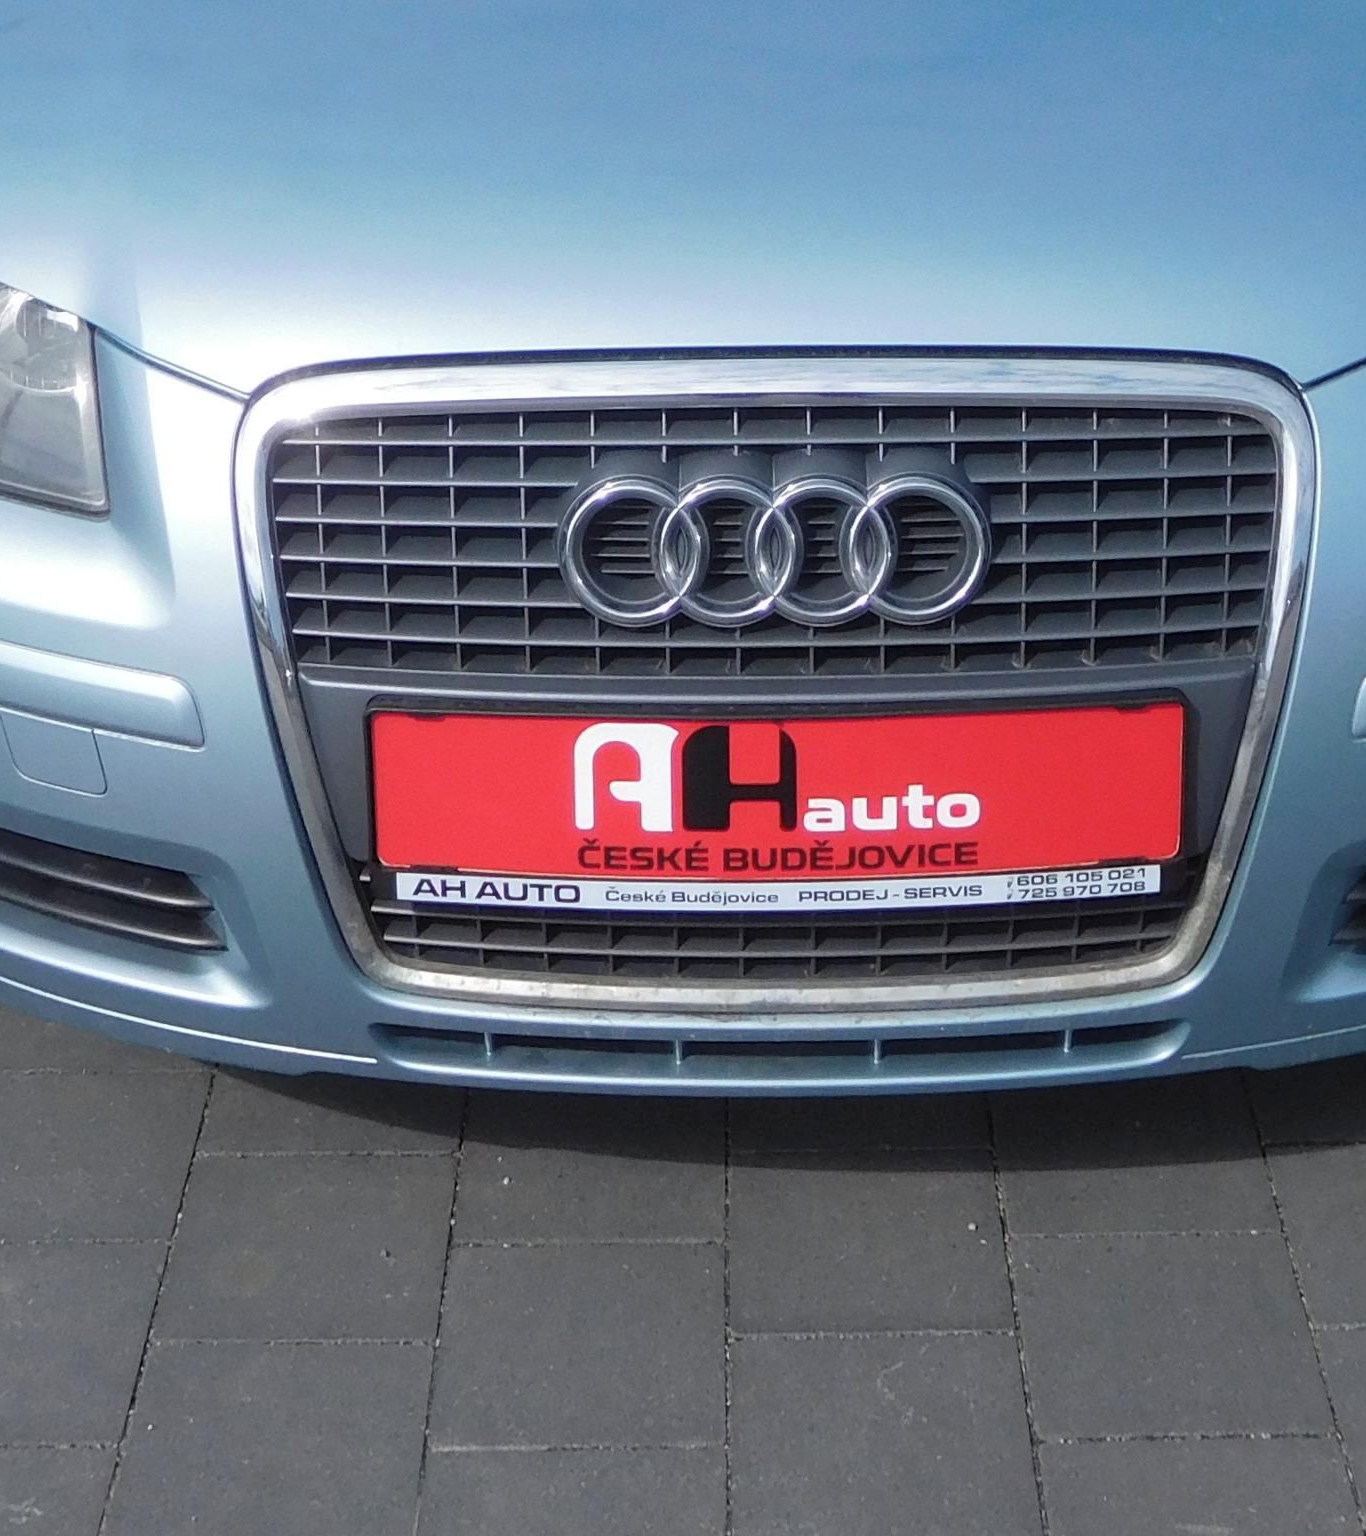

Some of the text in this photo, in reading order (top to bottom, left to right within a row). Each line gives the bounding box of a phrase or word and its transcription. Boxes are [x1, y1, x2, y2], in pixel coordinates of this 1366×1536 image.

[577, 838, 979, 872] ČESKÉ BUDĚJOVICE
[1017, 868, 1146, 886] 606 105 021
[413, 878, 466, 898] AH
[475, 881, 581, 904] AUTO
[605, 886, 666, 903] České
[672, 891, 779, 906] Budějovice
[799, 889, 888, 902] PRODEJ
[904, 885, 982, 899] SERVIS
[1019, 881, 1146, 899] 725 970 708
